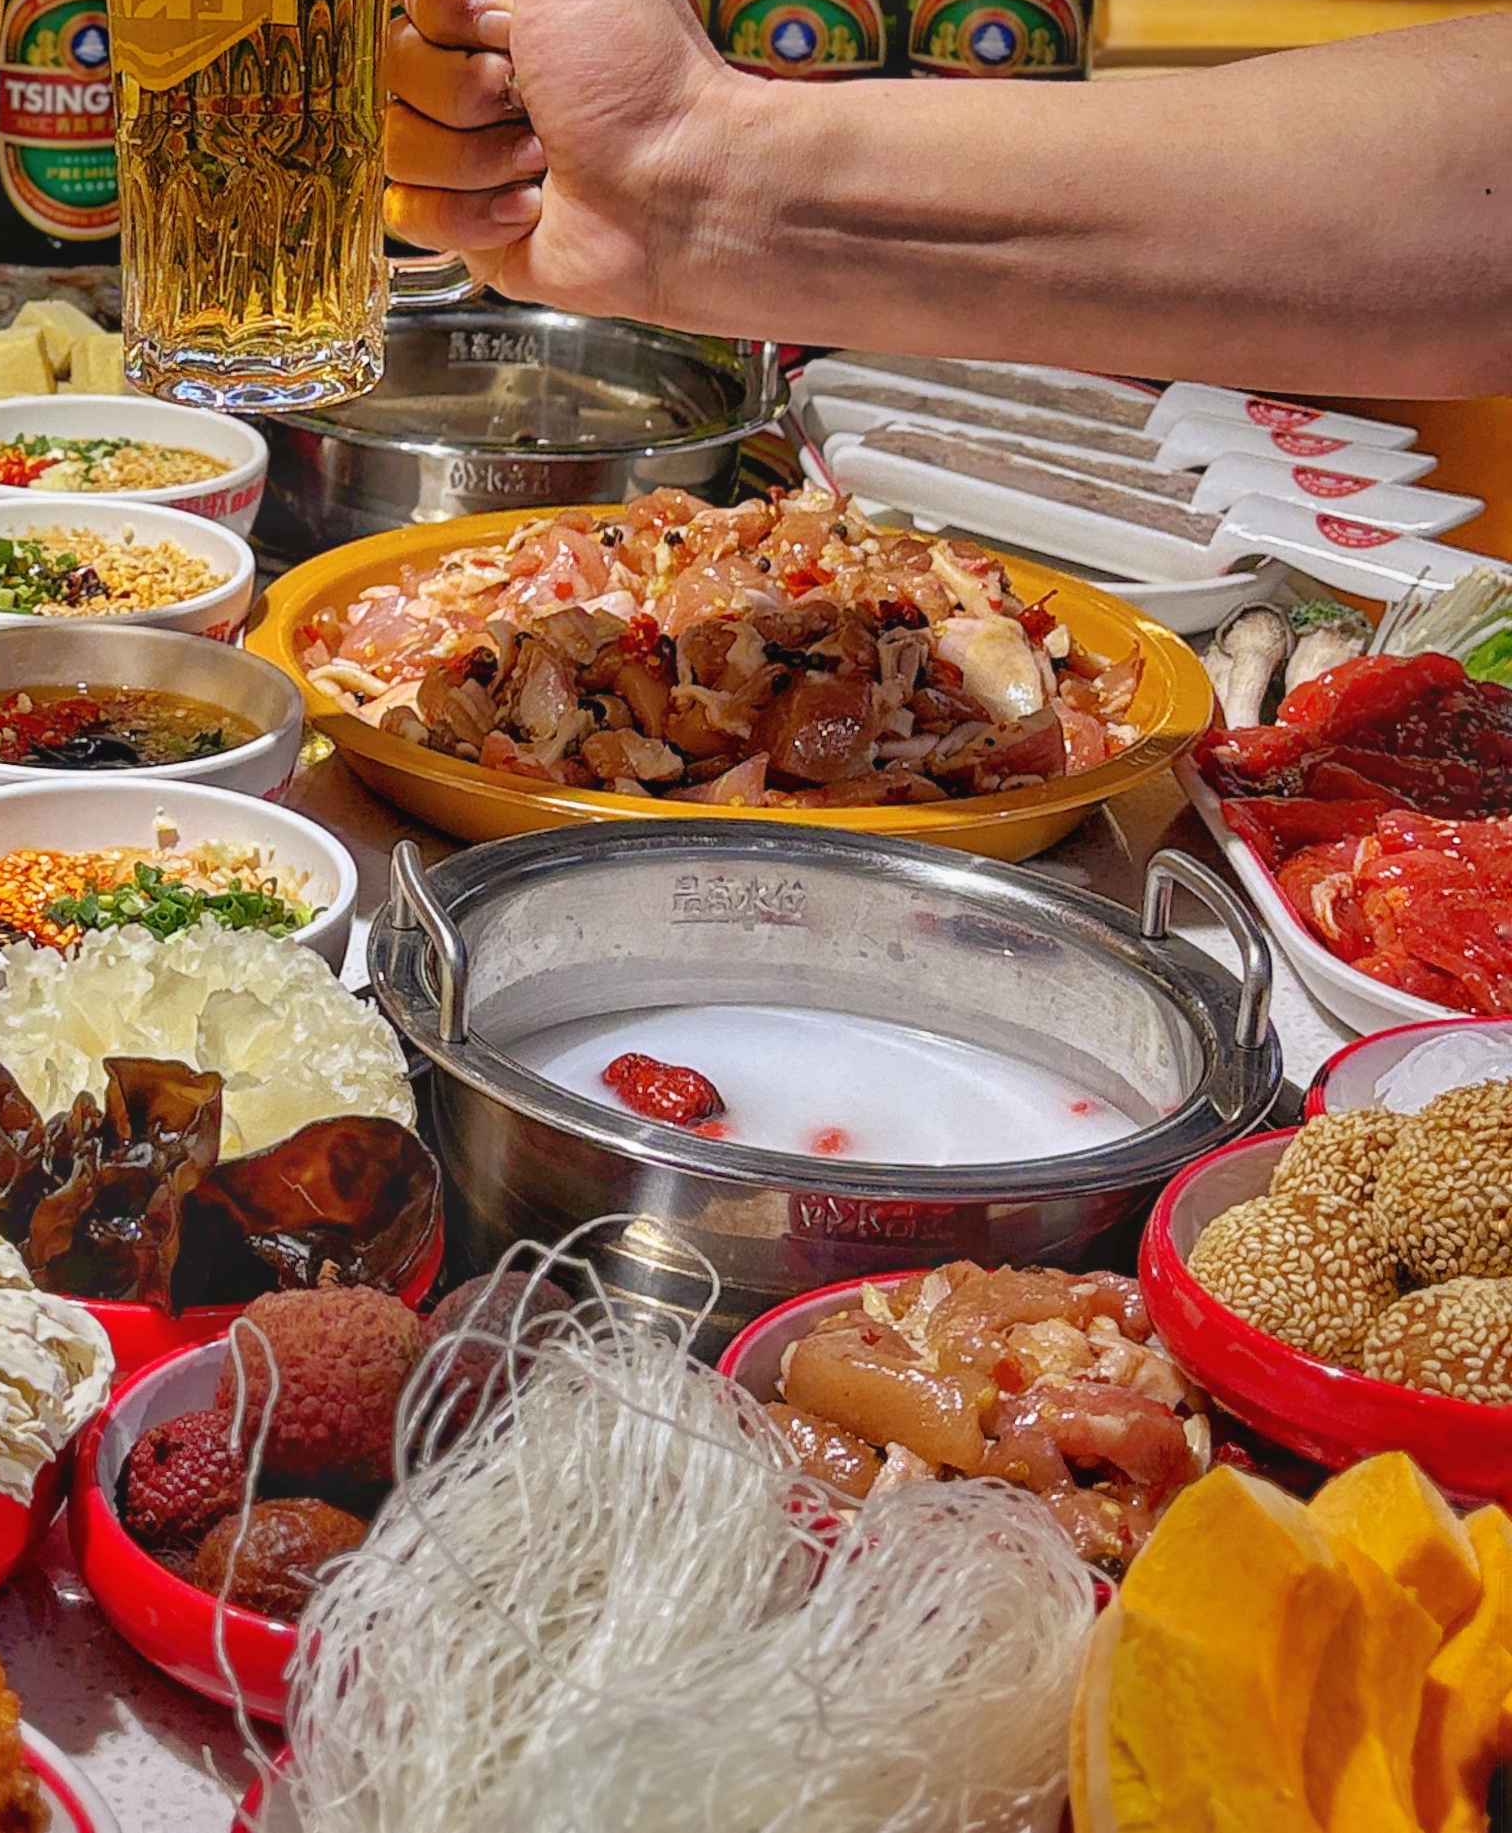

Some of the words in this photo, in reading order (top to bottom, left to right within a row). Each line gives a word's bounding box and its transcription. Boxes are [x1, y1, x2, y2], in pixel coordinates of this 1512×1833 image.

[5, 80, 112, 115] TSING
[671, 874, 810, 916] 最高水位
